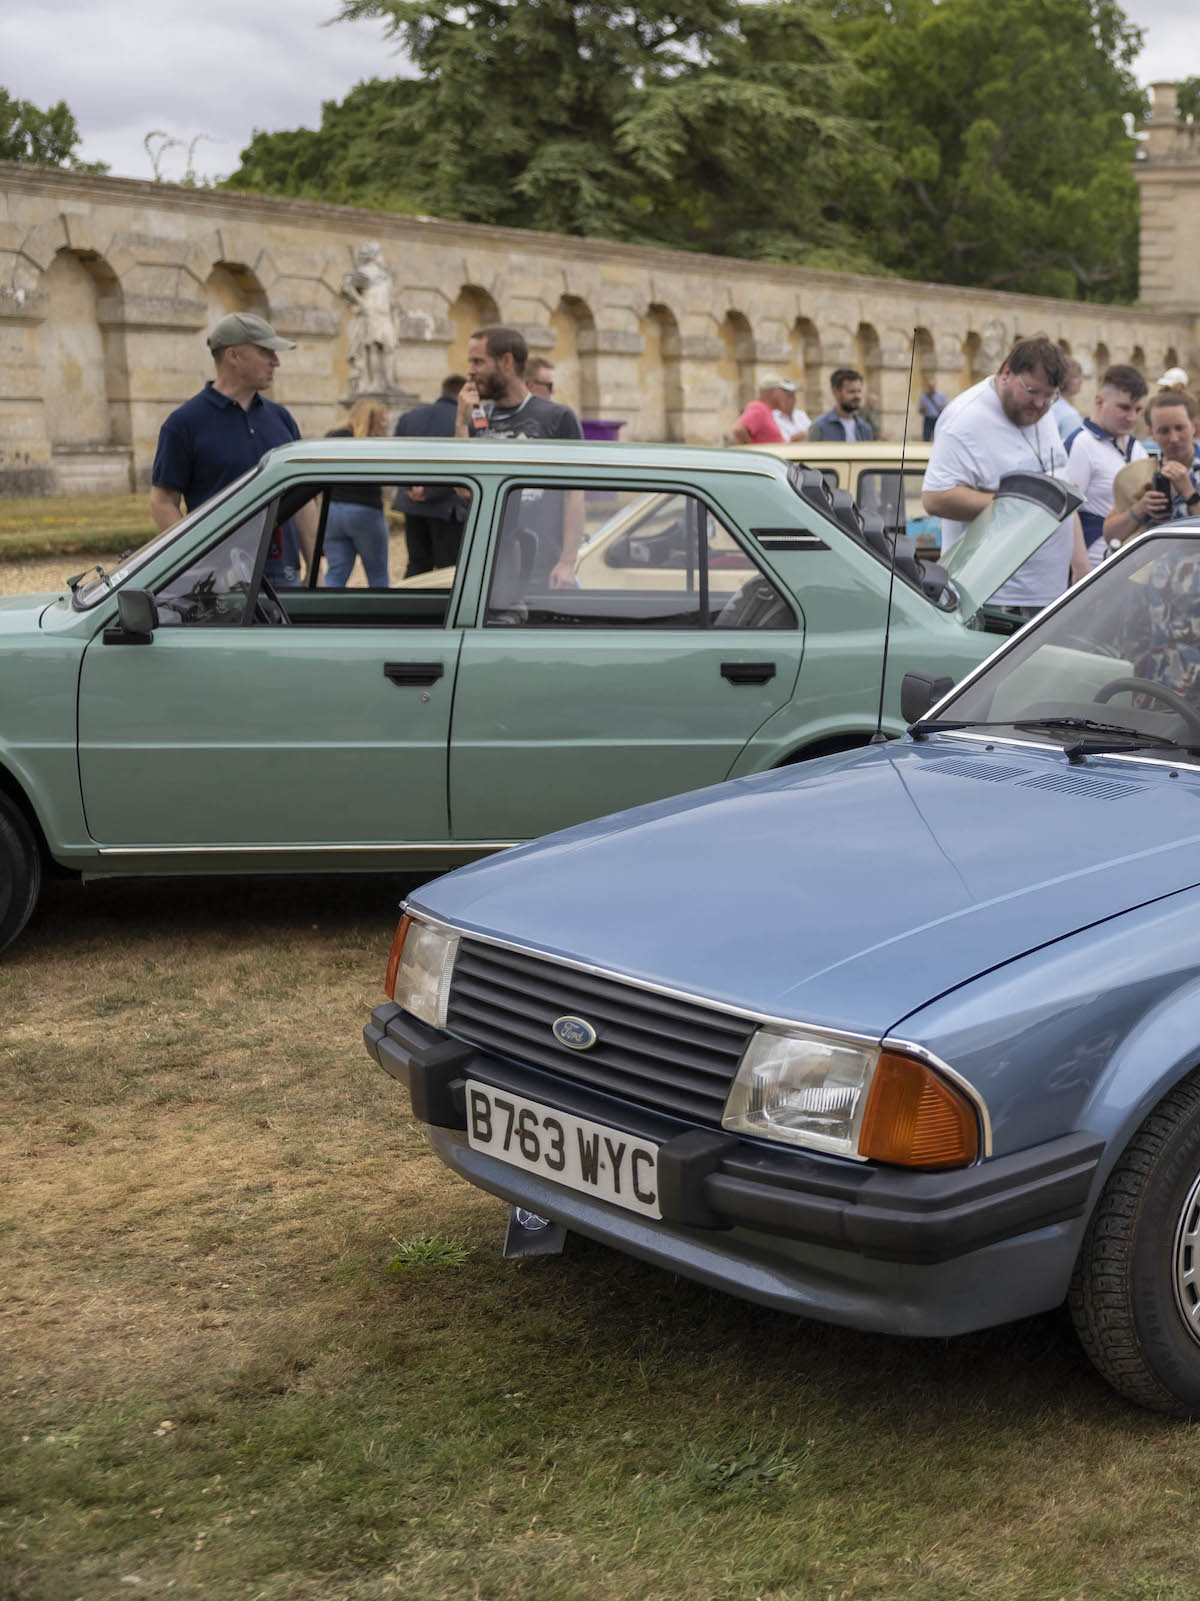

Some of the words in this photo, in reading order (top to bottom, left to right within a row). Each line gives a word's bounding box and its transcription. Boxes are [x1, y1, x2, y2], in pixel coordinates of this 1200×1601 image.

[560, 1021, 585, 1043] Ford
[471, 1089, 565, 1172] B763
[577, 1127, 656, 1205] WYC
